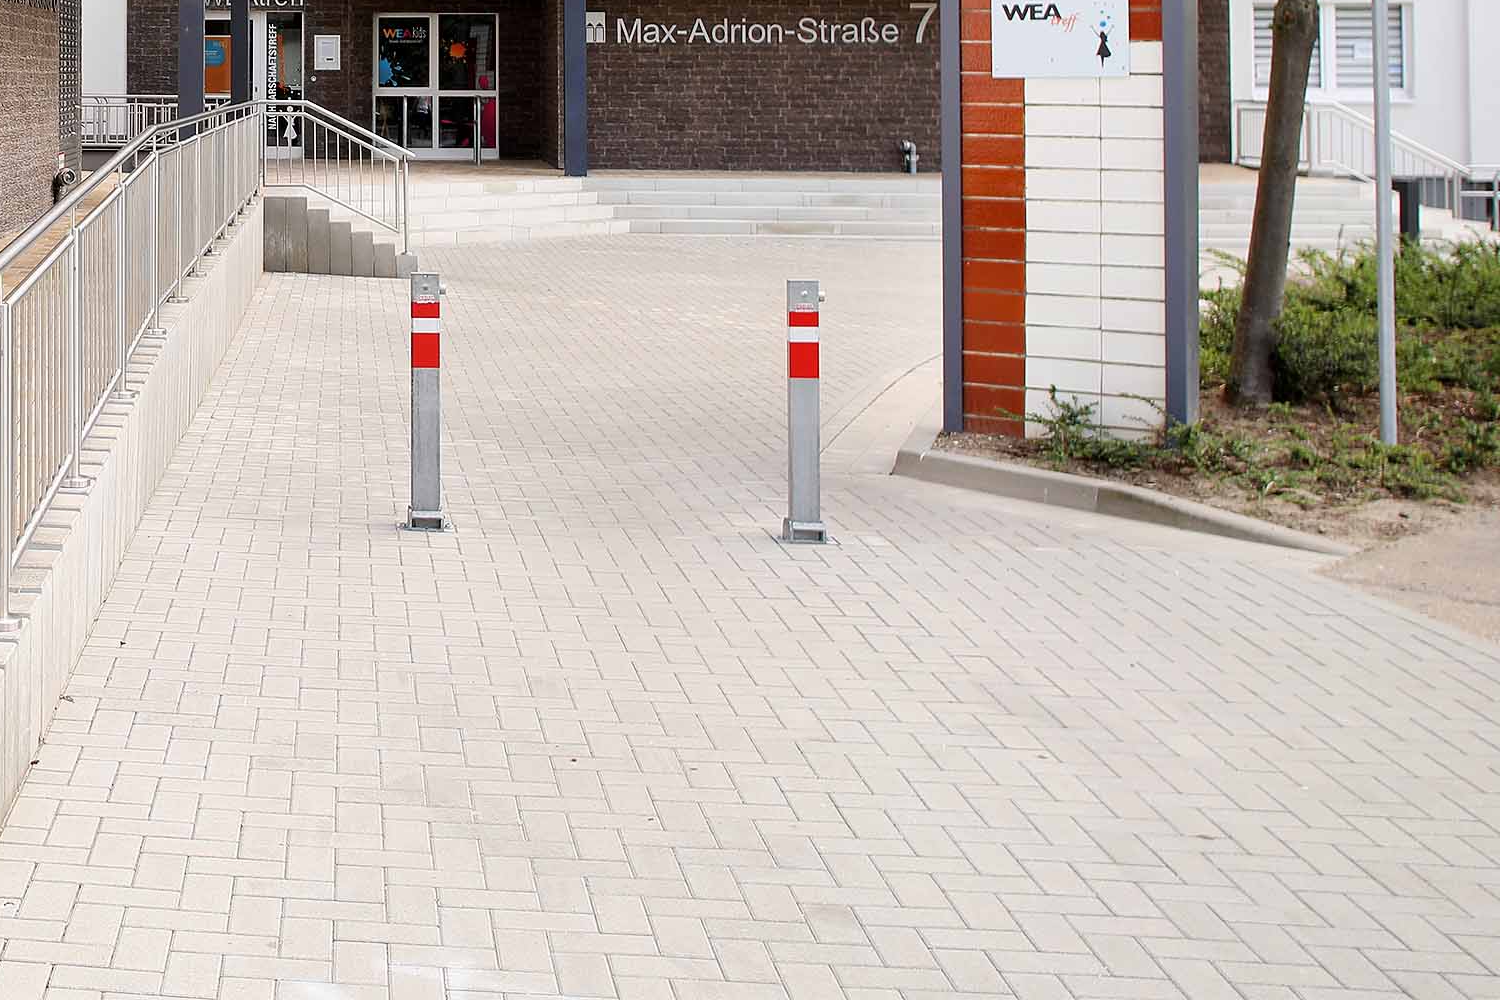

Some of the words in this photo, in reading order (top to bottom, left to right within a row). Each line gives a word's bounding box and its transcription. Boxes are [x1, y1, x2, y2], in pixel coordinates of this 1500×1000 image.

[1002, 3, 1062, 21] WEA
[616, 17, 900, 44] Max-Adrion-Straße
[909, 3, 937, 44] 7
[1050, 13, 1078, 32] treff
[383, 28, 411, 39] WEA
